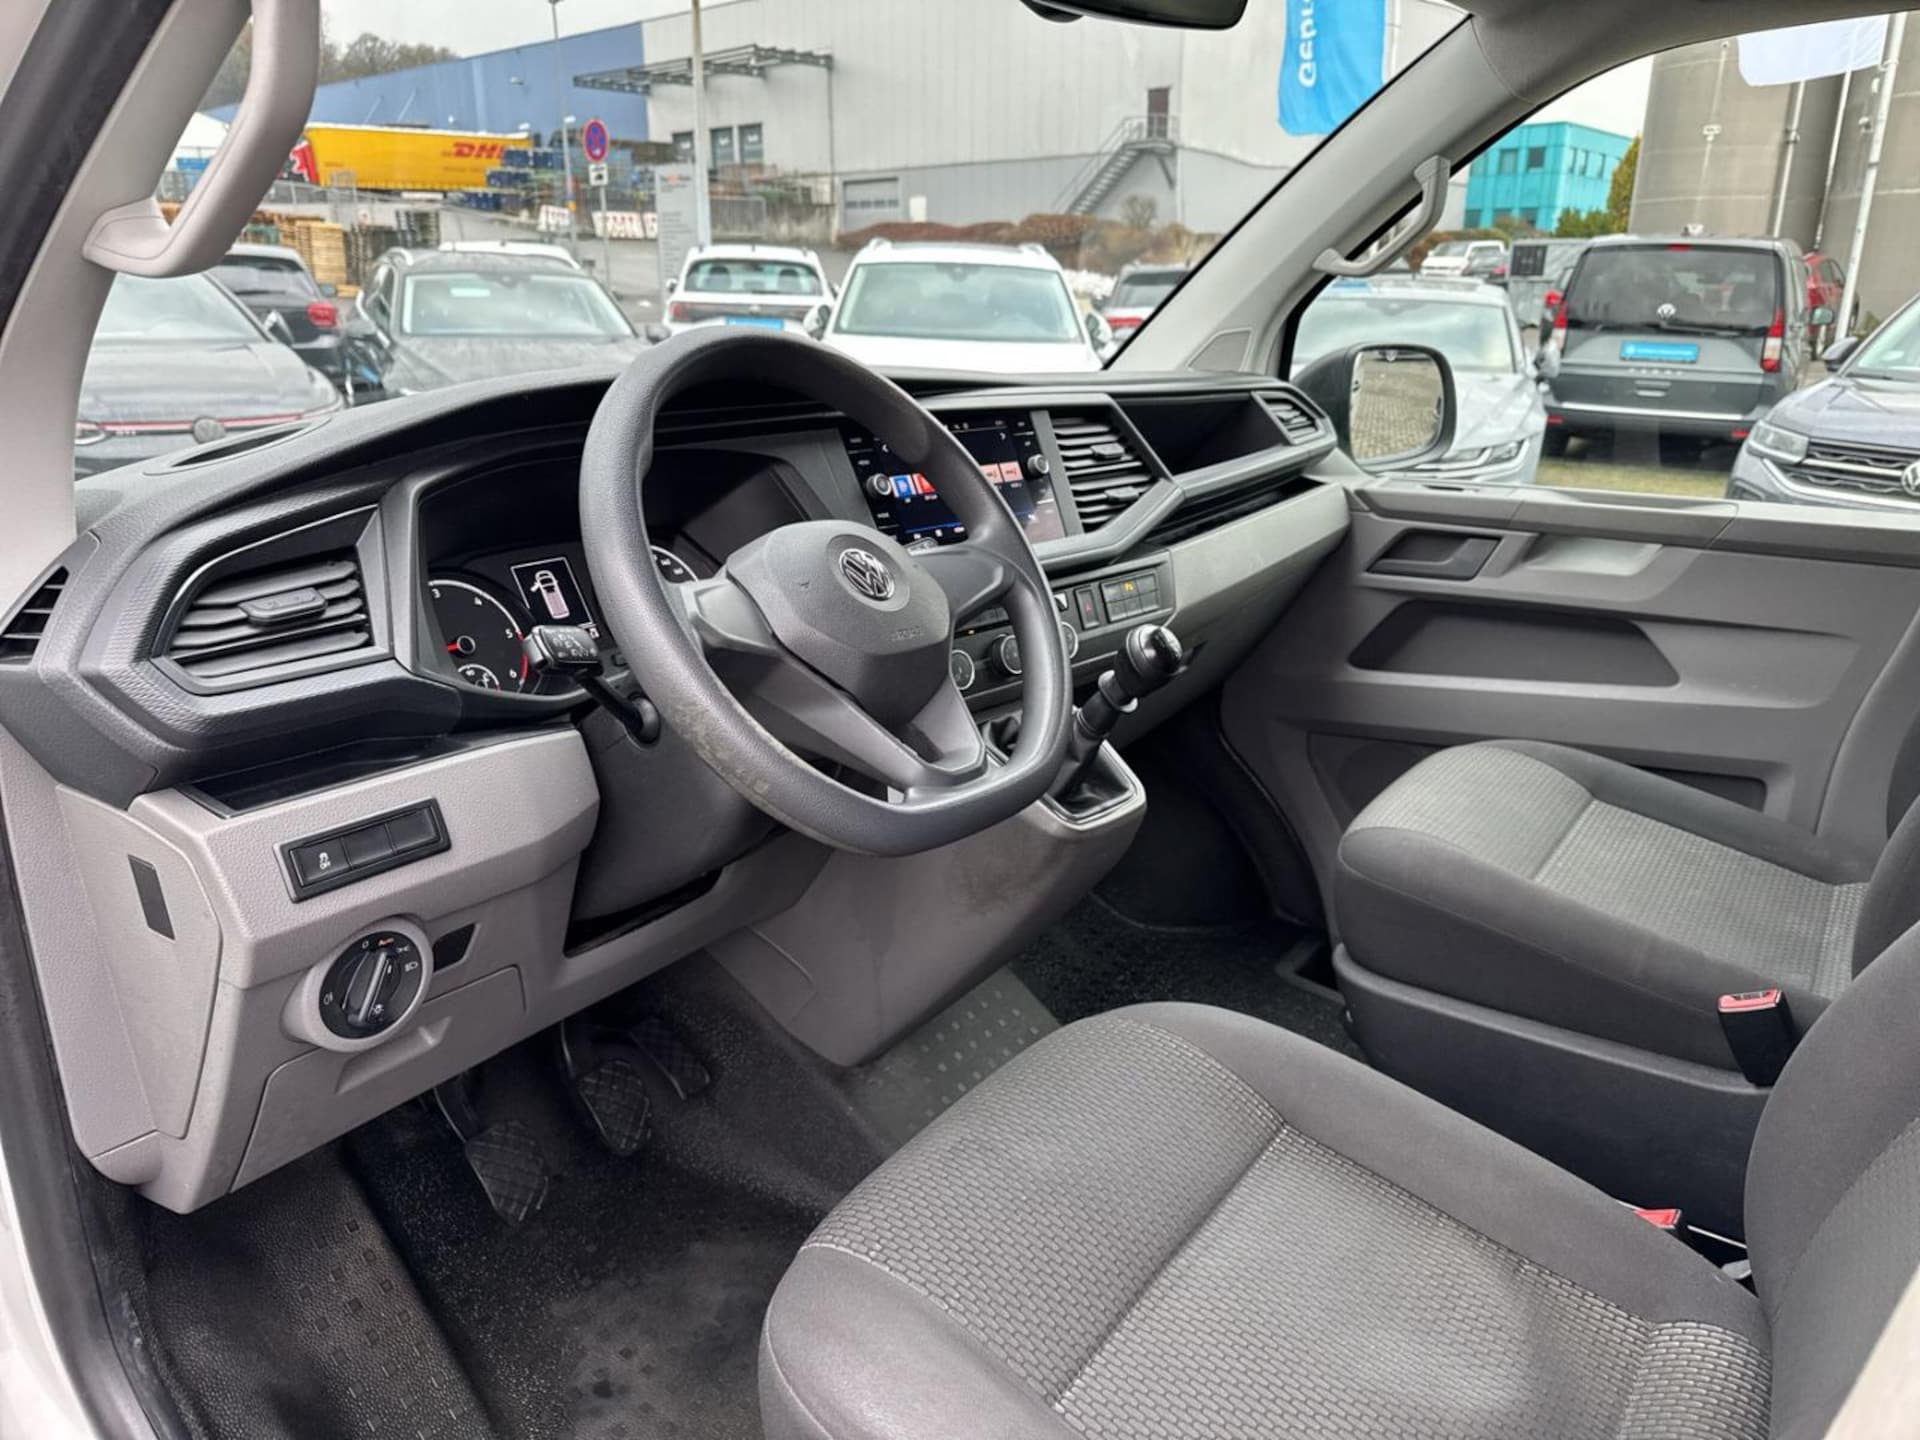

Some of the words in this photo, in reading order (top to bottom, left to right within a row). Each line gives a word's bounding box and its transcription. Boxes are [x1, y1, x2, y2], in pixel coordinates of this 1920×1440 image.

[454, 142, 505, 158] DH
[432, 588, 441, 599] 3
[505, 628, 514, 639] 5
[509, 668, 518, 679] 6
